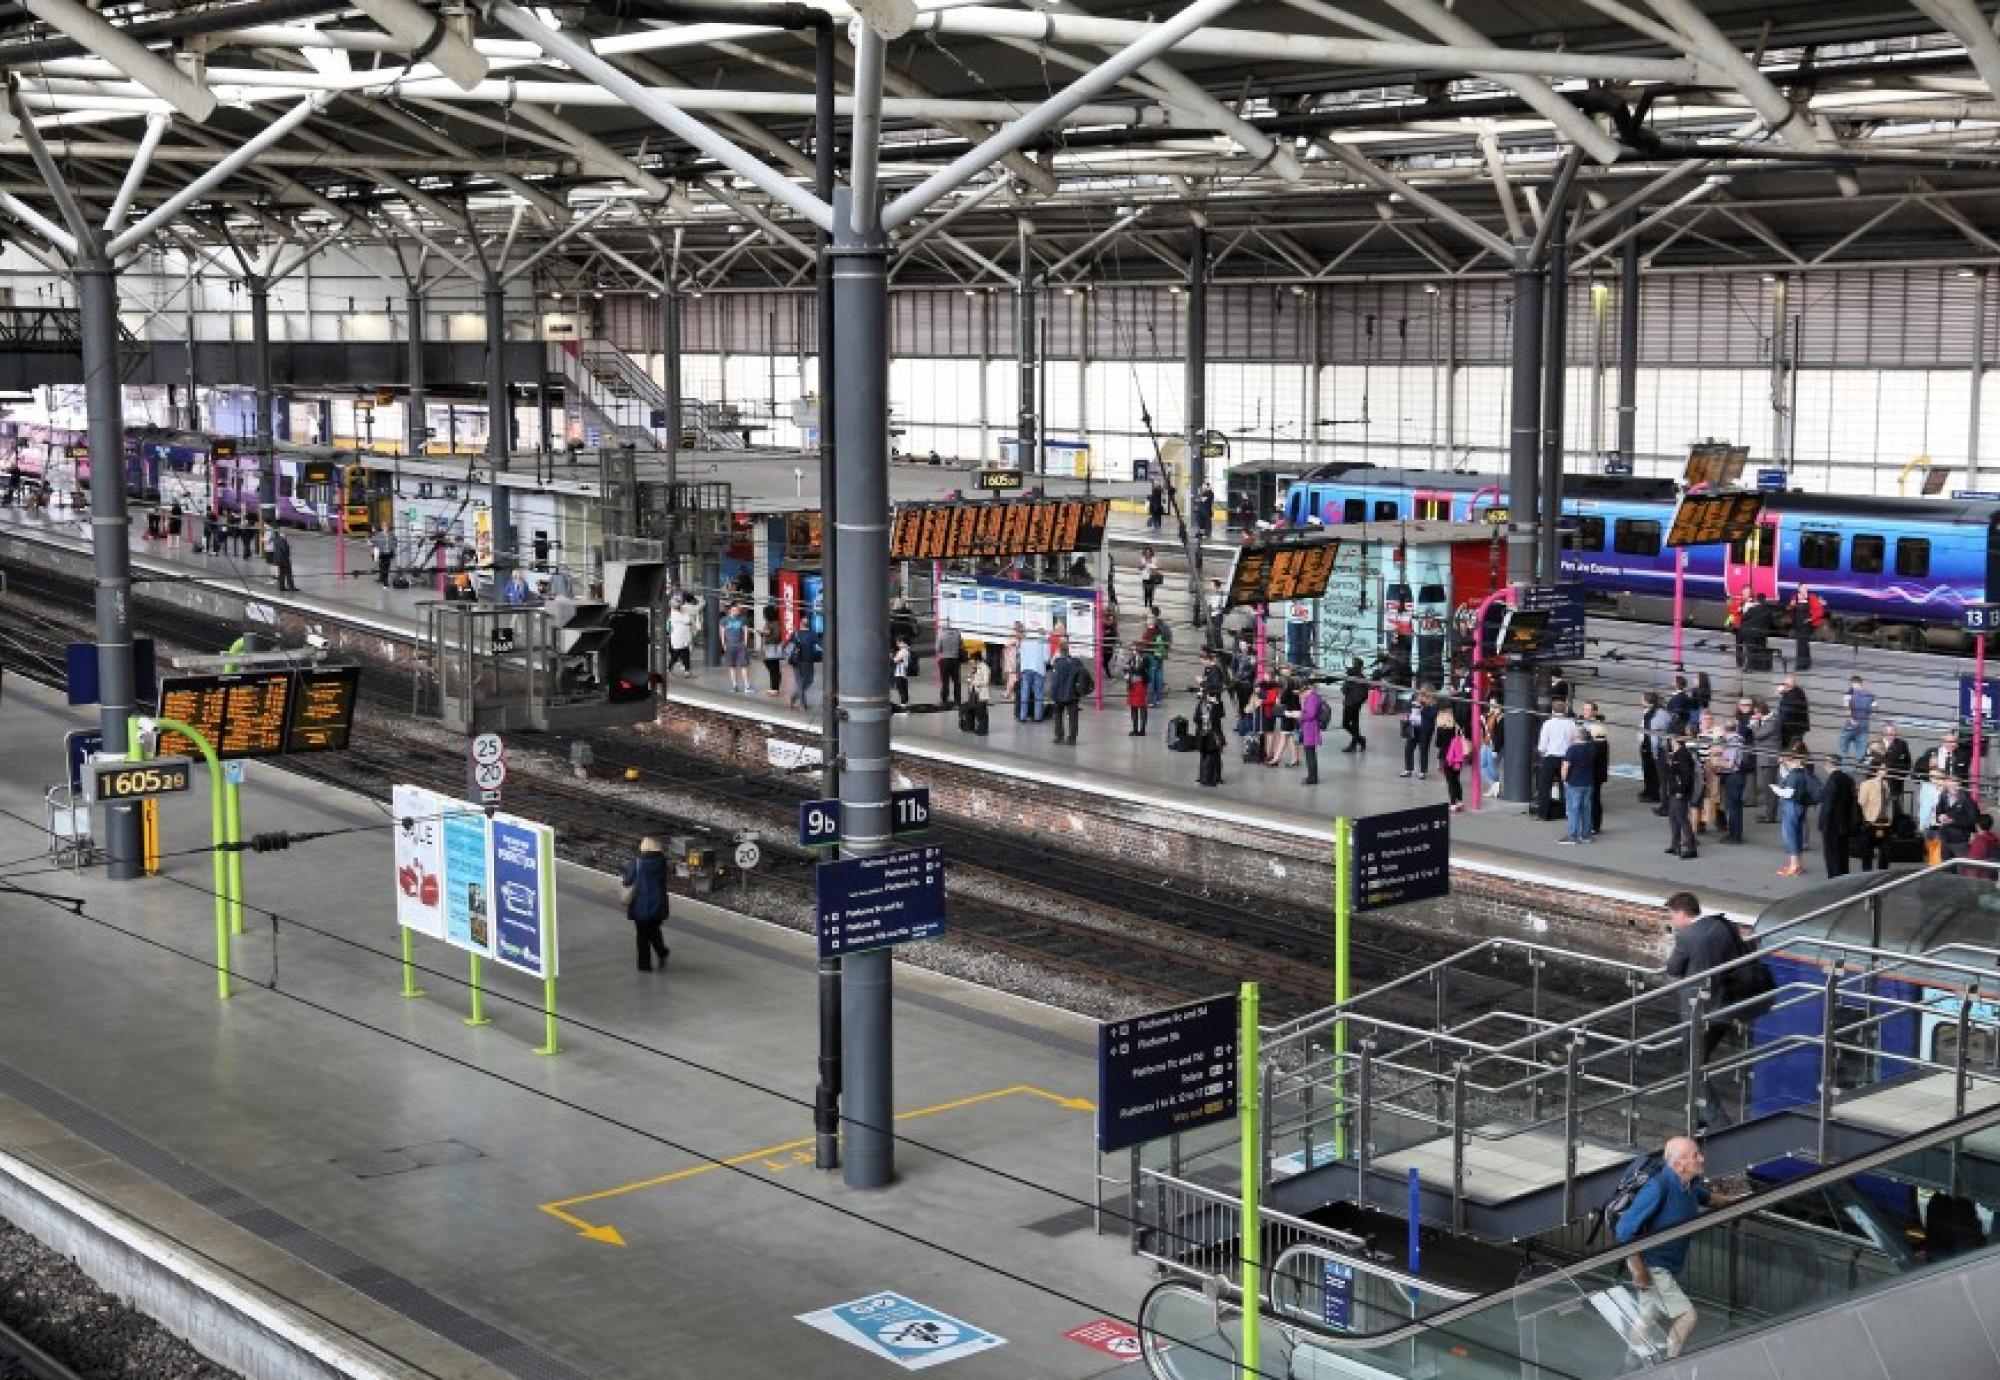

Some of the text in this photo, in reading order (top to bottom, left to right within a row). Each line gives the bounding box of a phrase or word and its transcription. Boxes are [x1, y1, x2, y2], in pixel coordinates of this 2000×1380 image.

[1966, 610, 1982, 626] 13
[478, 739, 497, 758] 25
[480, 764, 500, 782] 20
[898, 797, 927, 824] 11b
[808, 809, 835, 836] 9b
[740, 848, 757, 864] 20
